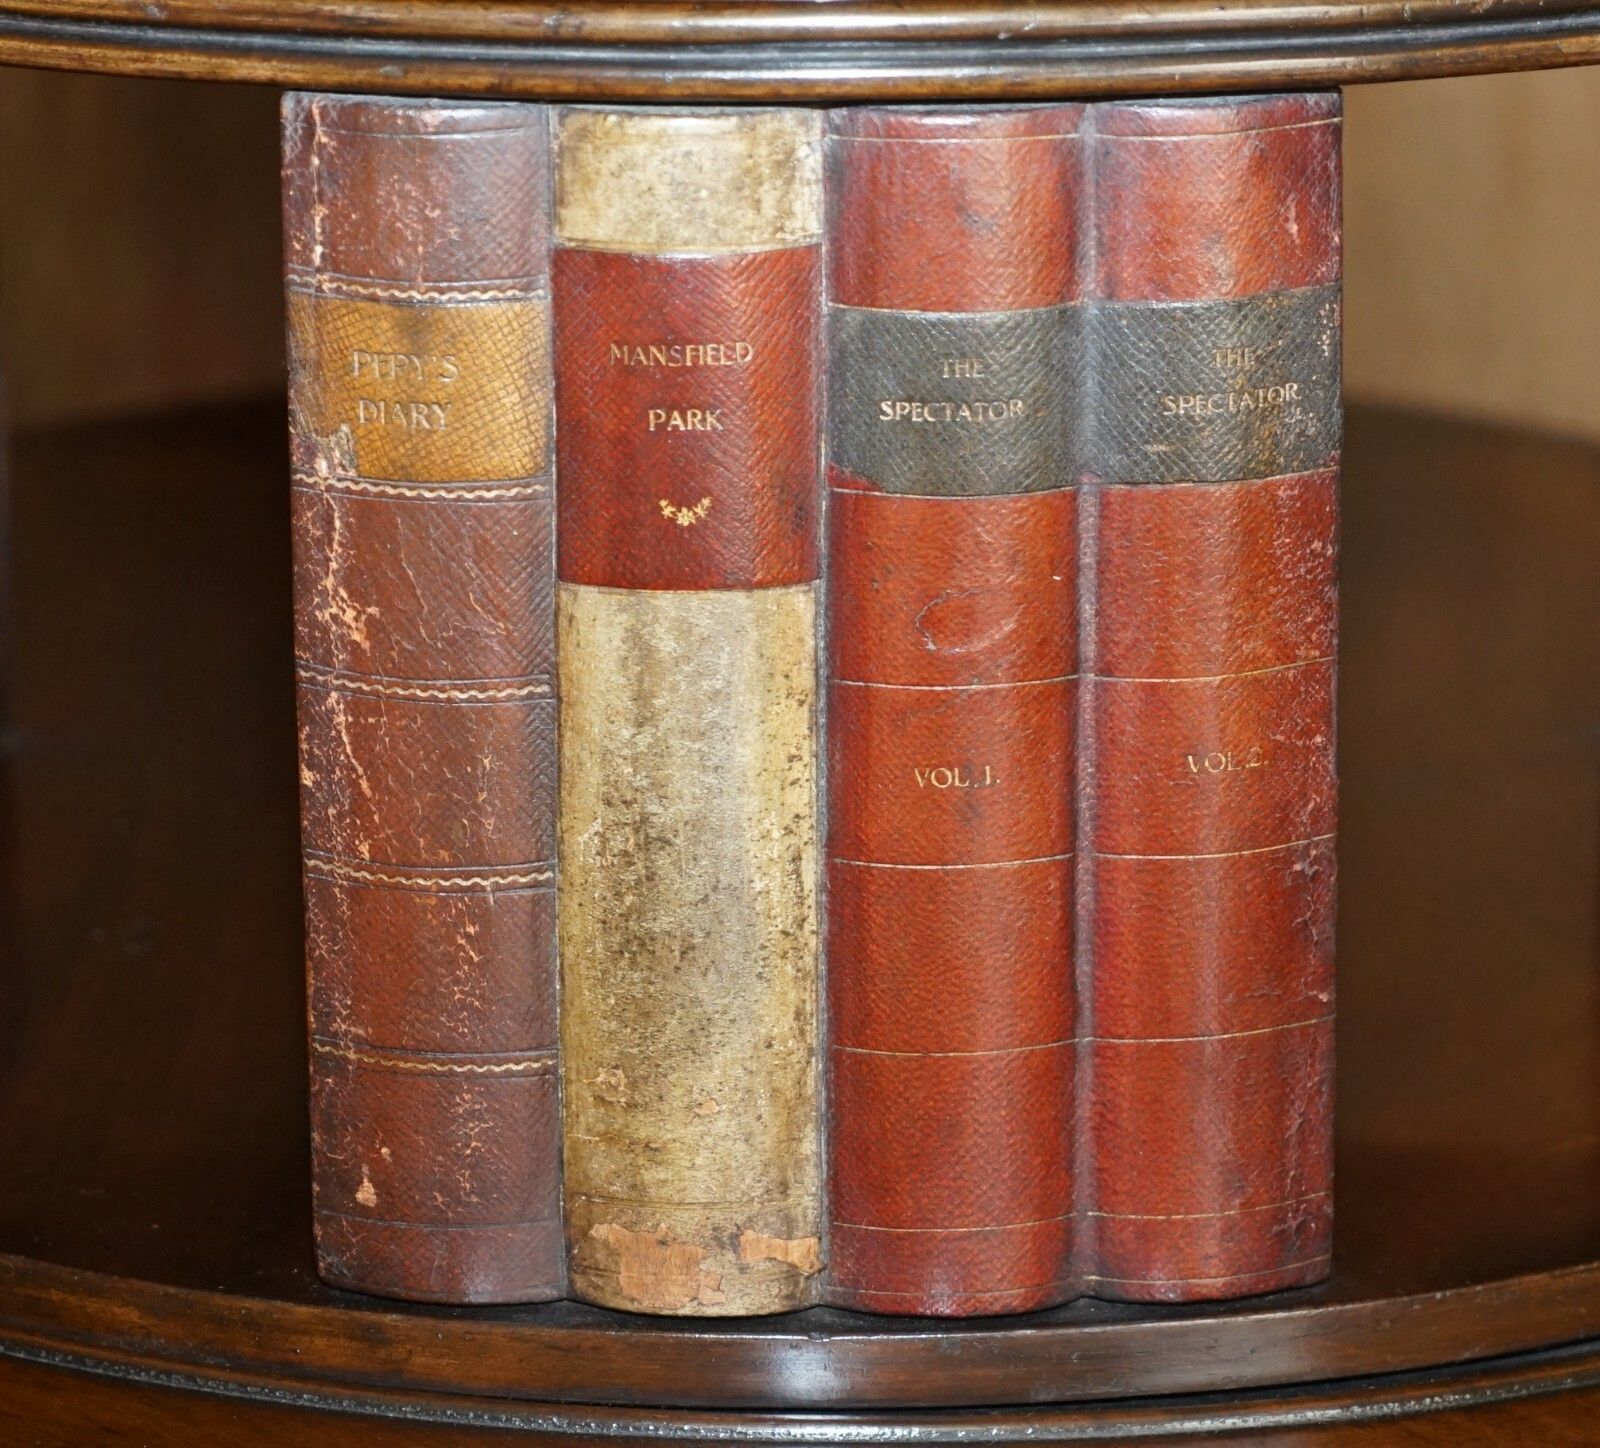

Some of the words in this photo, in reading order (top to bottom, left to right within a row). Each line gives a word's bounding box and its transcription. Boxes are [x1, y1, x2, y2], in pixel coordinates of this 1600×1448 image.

[609, 342, 754, 367] MANSFIELD
[940, 358, 985, 379] THE
[879, 399, 1026, 422] SPECTATOR
[1161, 382, 1301, 415] SPECTATOR
[359, 399, 452, 430] DIARY
[648, 409, 724, 431] PARK
